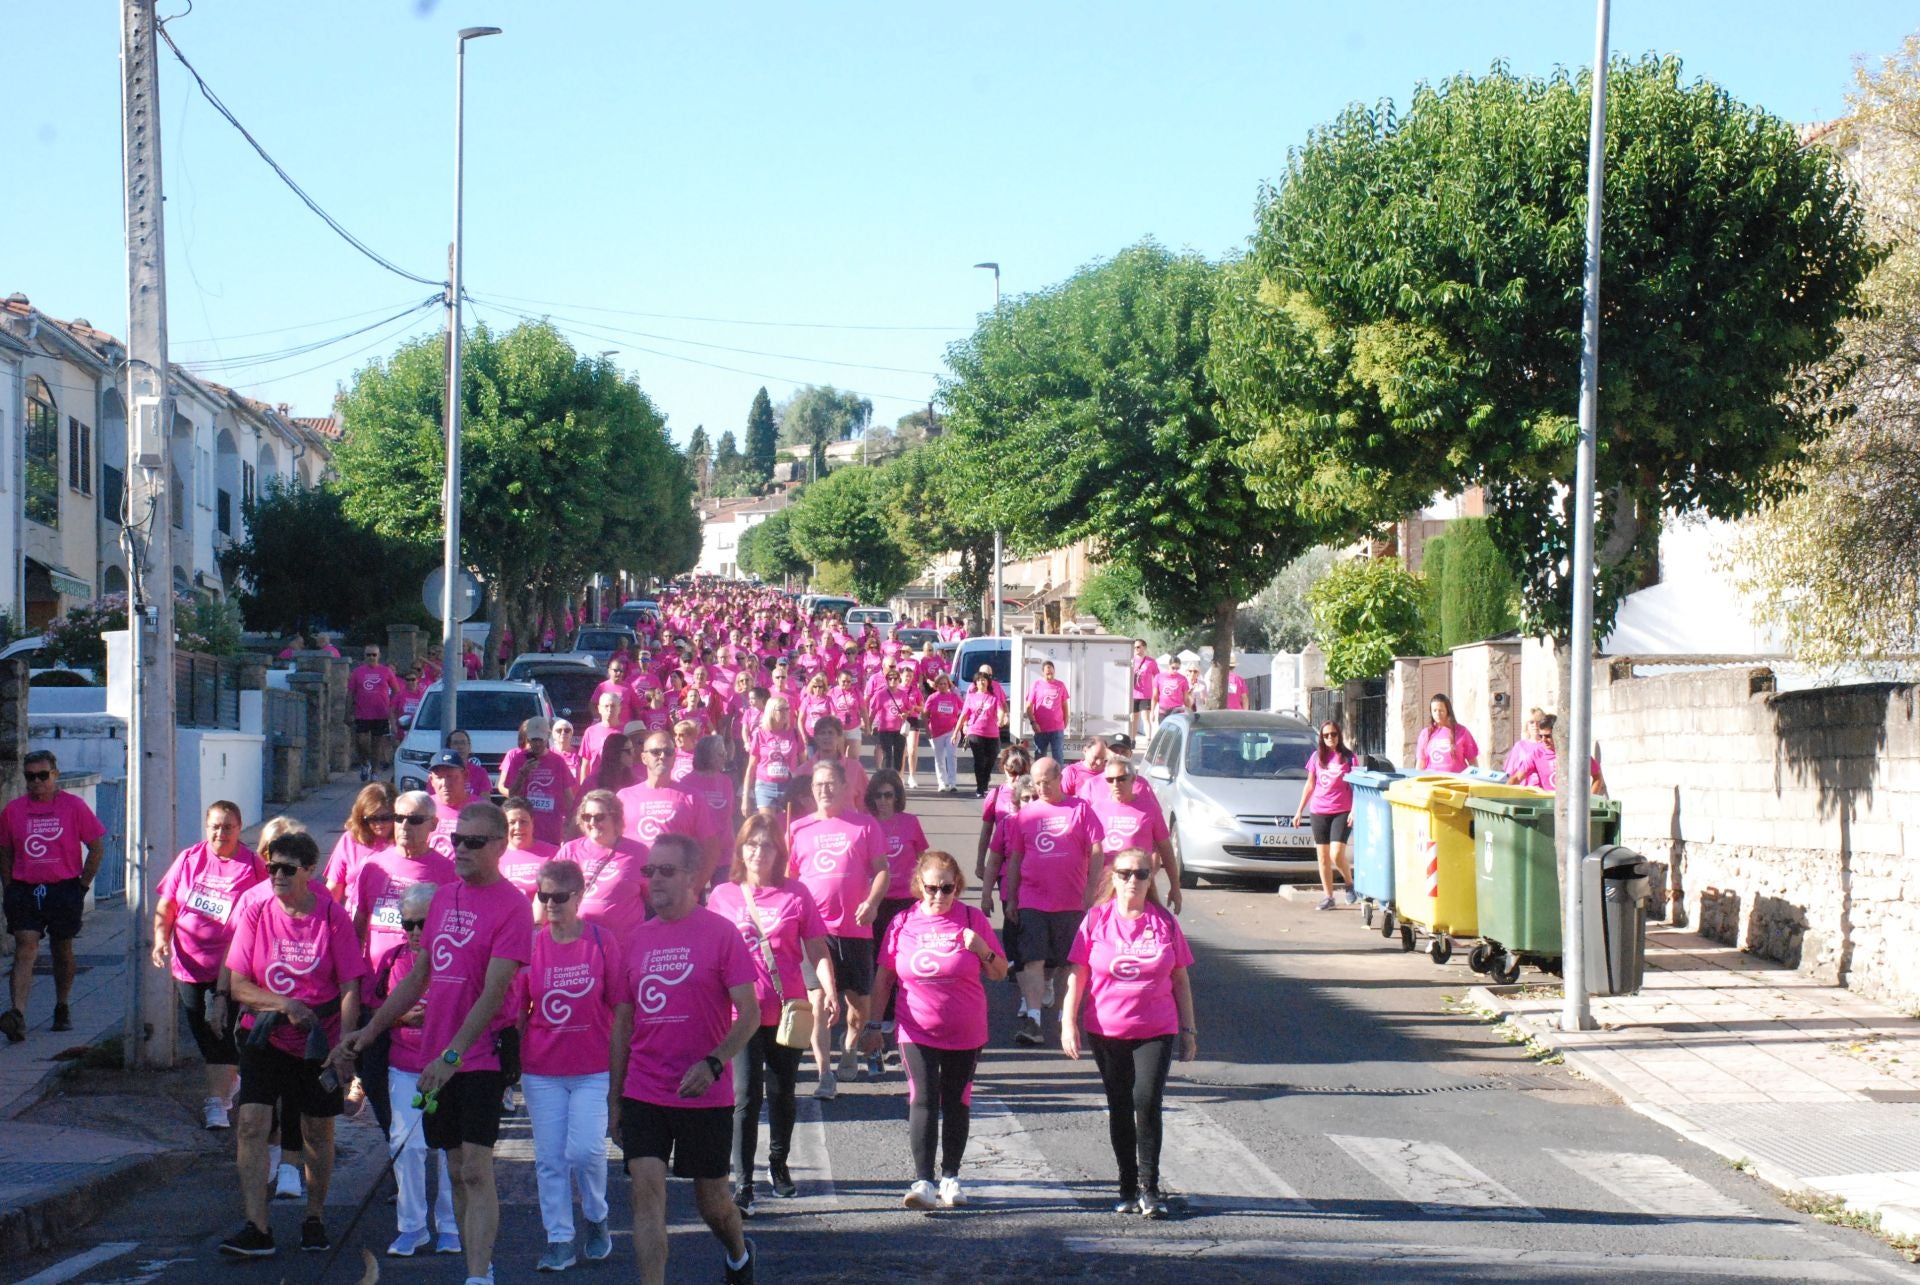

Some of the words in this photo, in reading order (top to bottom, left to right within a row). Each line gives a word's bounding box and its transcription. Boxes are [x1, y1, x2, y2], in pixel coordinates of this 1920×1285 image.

[1262, 835, 1288, 845] 4844
[1292, 835, 1312, 845] CNV
[194, 897, 224, 914] 0639
[380, 912, 403, 924] 085
[280, 952, 315, 963] cáncer
[650, 953, 677, 963] contra
[679, 952, 688, 960] el
[649, 961, 688, 973] cáncer
[553, 971, 580, 979] contra
[553, 976, 590, 988] cáncer
